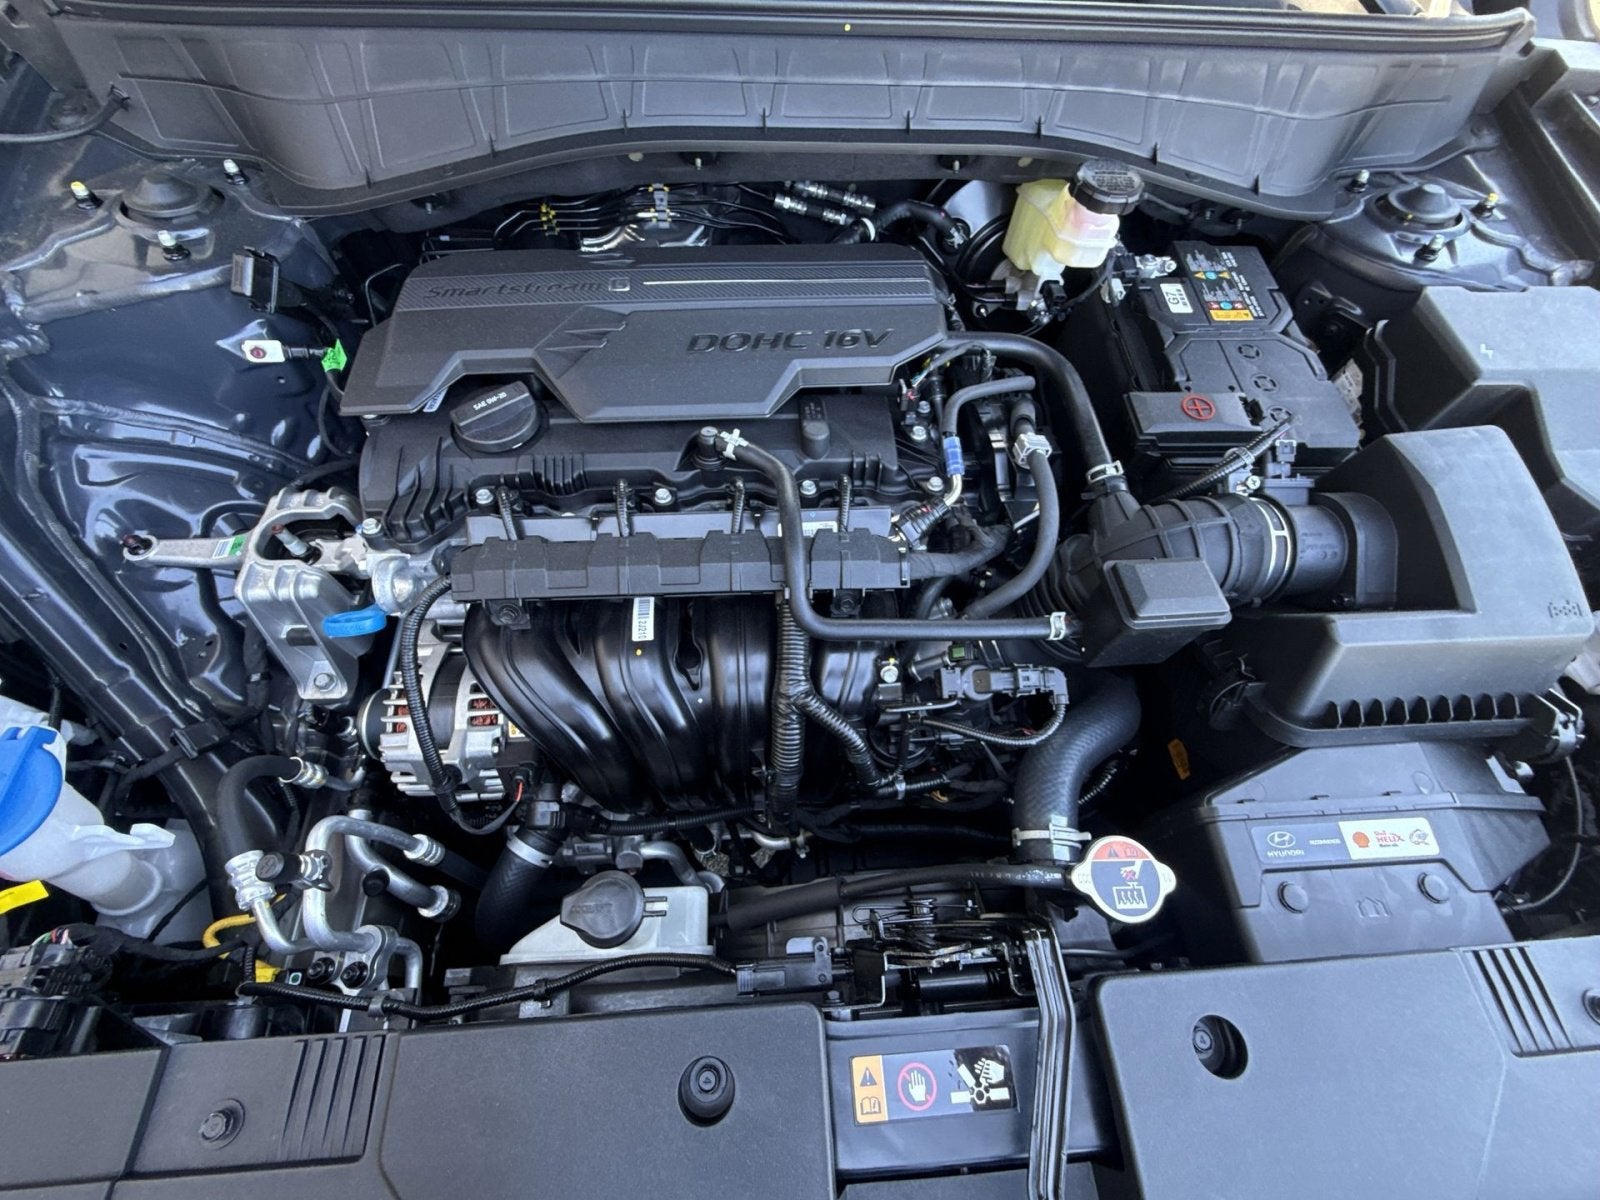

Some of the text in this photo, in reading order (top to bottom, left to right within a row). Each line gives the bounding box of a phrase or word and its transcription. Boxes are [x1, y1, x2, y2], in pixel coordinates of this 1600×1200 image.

[424, 281, 601, 299] Smartstream
[685, 328, 896, 353] DOHC 16V
[473, 400, 488, 411] SAE
[1267, 848, 1305, 858] HYUNDAI
